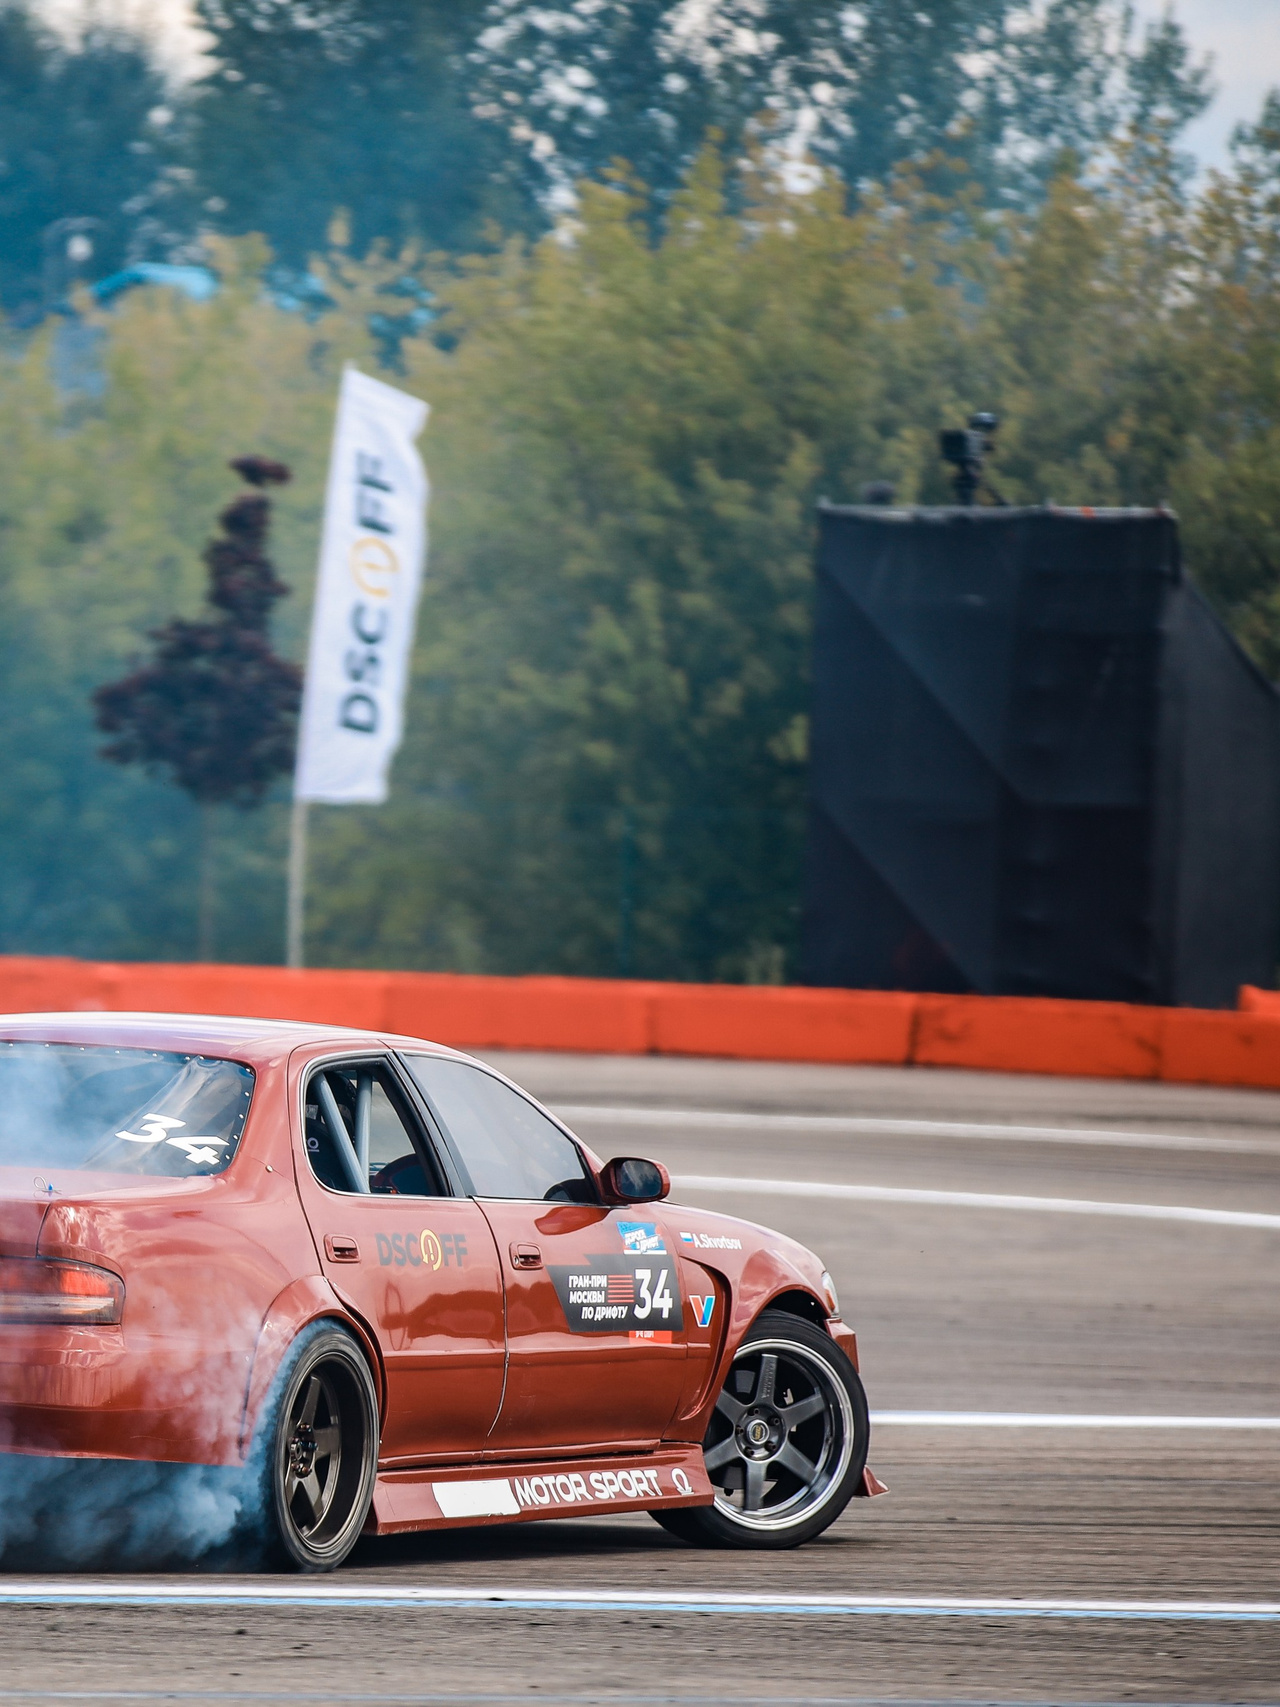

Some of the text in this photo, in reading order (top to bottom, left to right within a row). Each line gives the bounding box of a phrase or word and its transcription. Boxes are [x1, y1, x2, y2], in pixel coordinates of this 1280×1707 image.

[114, 1112, 230, 1166] 34
[568, 1275, 608, 1288] ГРАН-ПРИ
[633, 1268, 673, 1319] 34
[569, 1290, 605, 1304] МОСКВЫ
[581, 1305, 628, 1321] ПО ДРИФТУ
[514, 1469, 663, 1507] MOTOR SPORT
